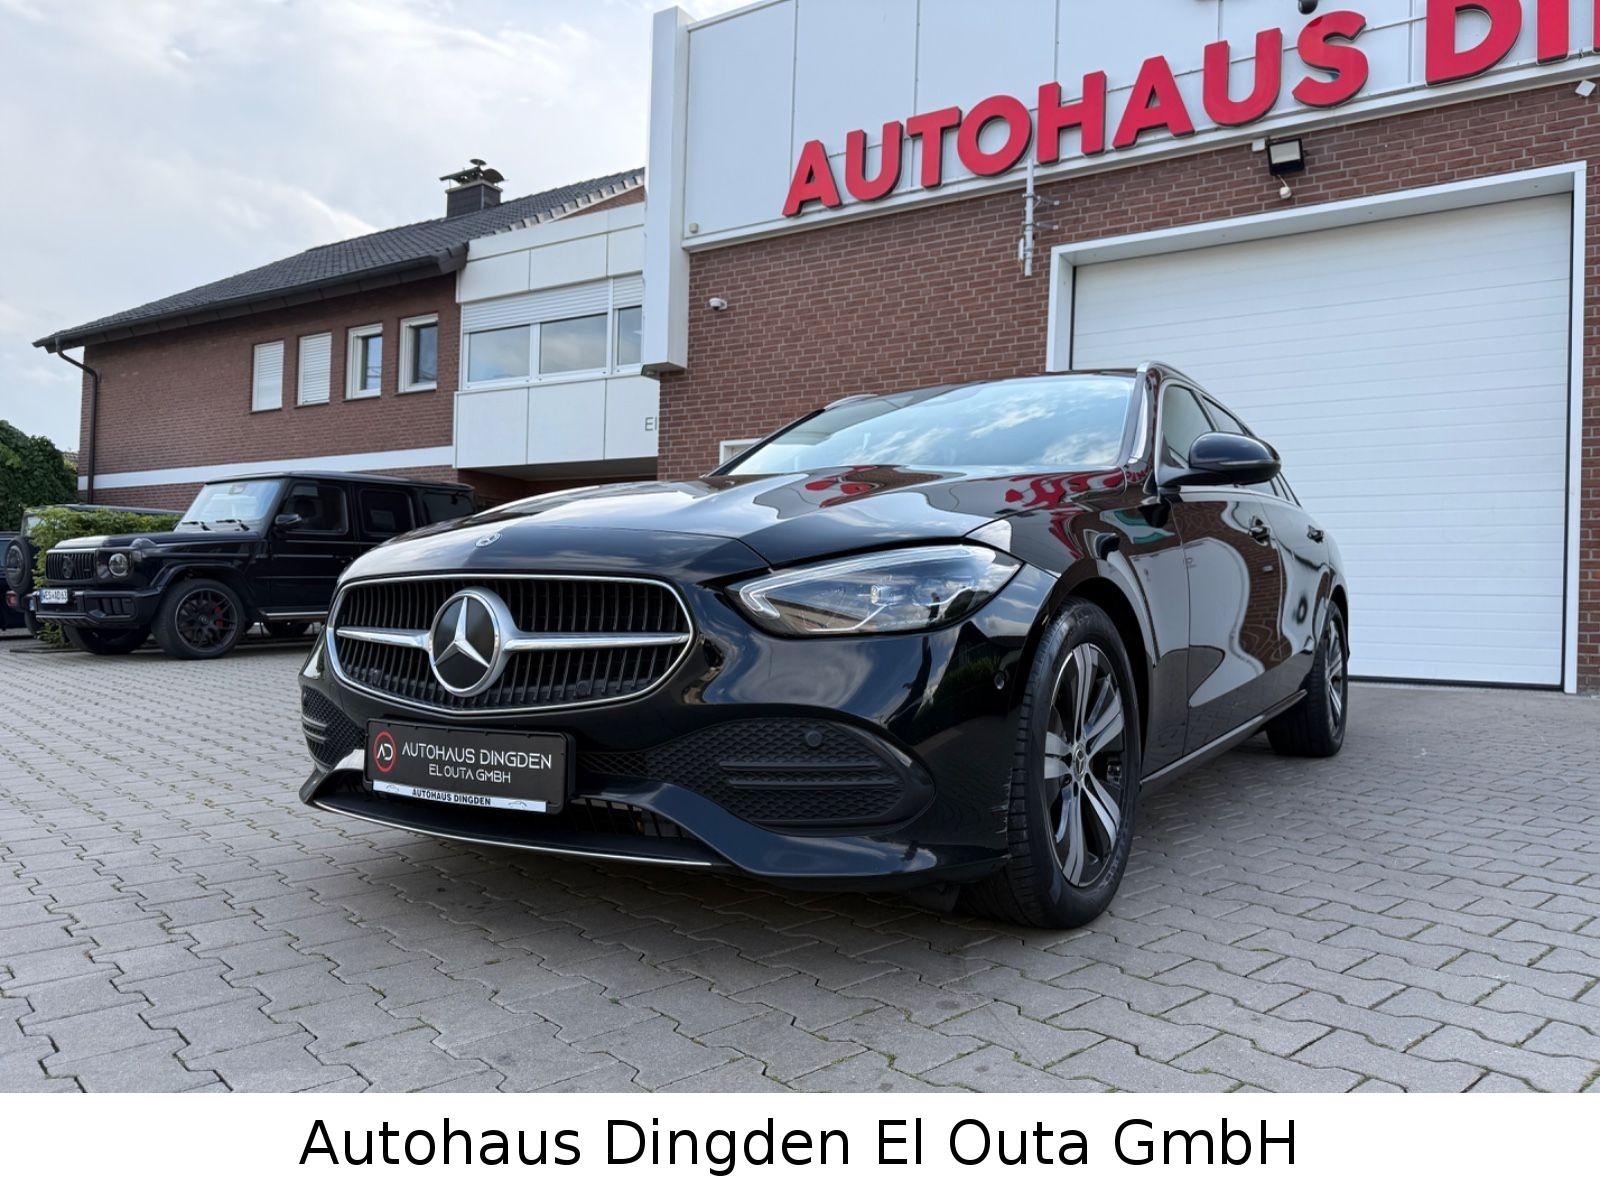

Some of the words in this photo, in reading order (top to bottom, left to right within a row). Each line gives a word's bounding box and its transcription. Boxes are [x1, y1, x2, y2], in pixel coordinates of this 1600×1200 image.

[782, 10, 1369, 217] AUTOHAUS
[1425, 0, 1600, 85] DI
[402, 741, 475, 765] AUTOHAUS
[480, 749, 552, 770] DINGDEN
[444, 765, 475, 780] OUTA
[476, 769, 511, 784] GMBH
[411, 788, 451, 802] AUTOHAUS
[453, 794, 491, 806] DINGDEN
